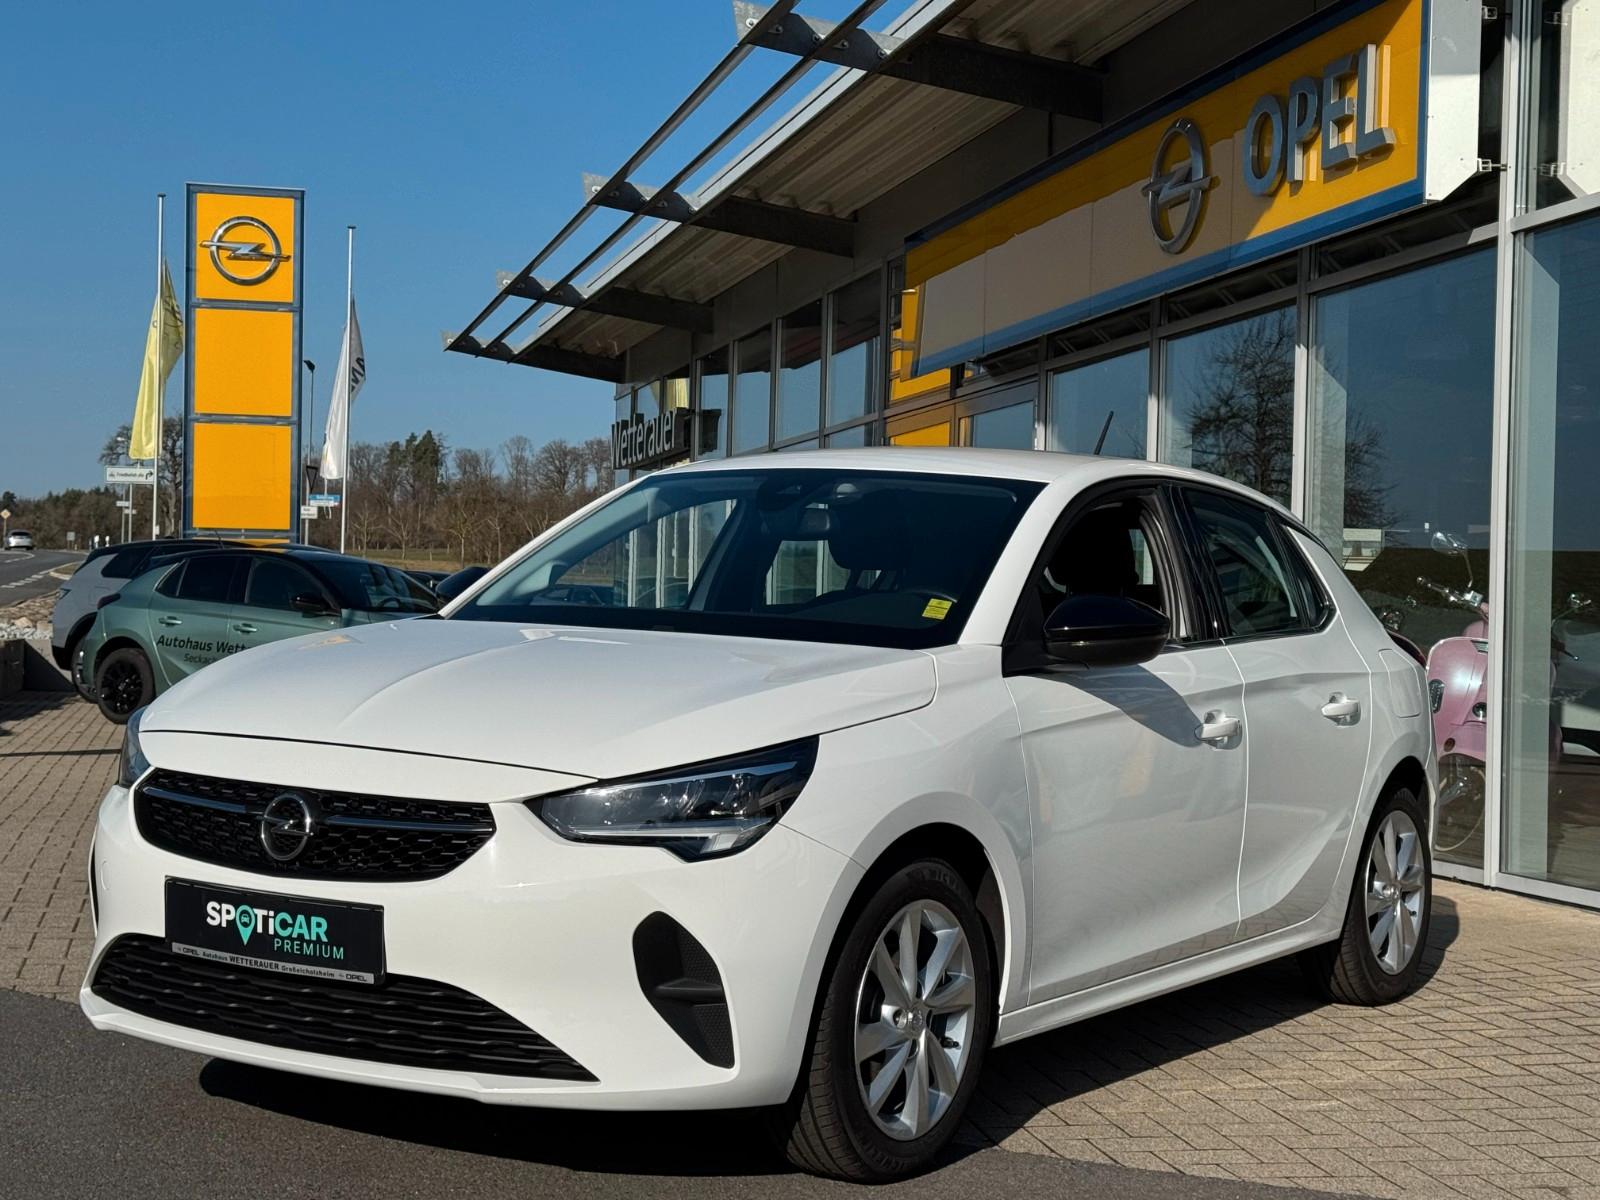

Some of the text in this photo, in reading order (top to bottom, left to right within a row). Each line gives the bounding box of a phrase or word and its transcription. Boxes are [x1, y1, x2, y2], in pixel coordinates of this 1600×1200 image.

[1242, 43, 1397, 197] OPEL
[610, 407, 678, 470] Wetterauer
[156, 634, 253, 654] Autohaus Wett
[274, 938, 344, 960] PREMIUM
[229, 955, 280, 970] WETTERAUER
